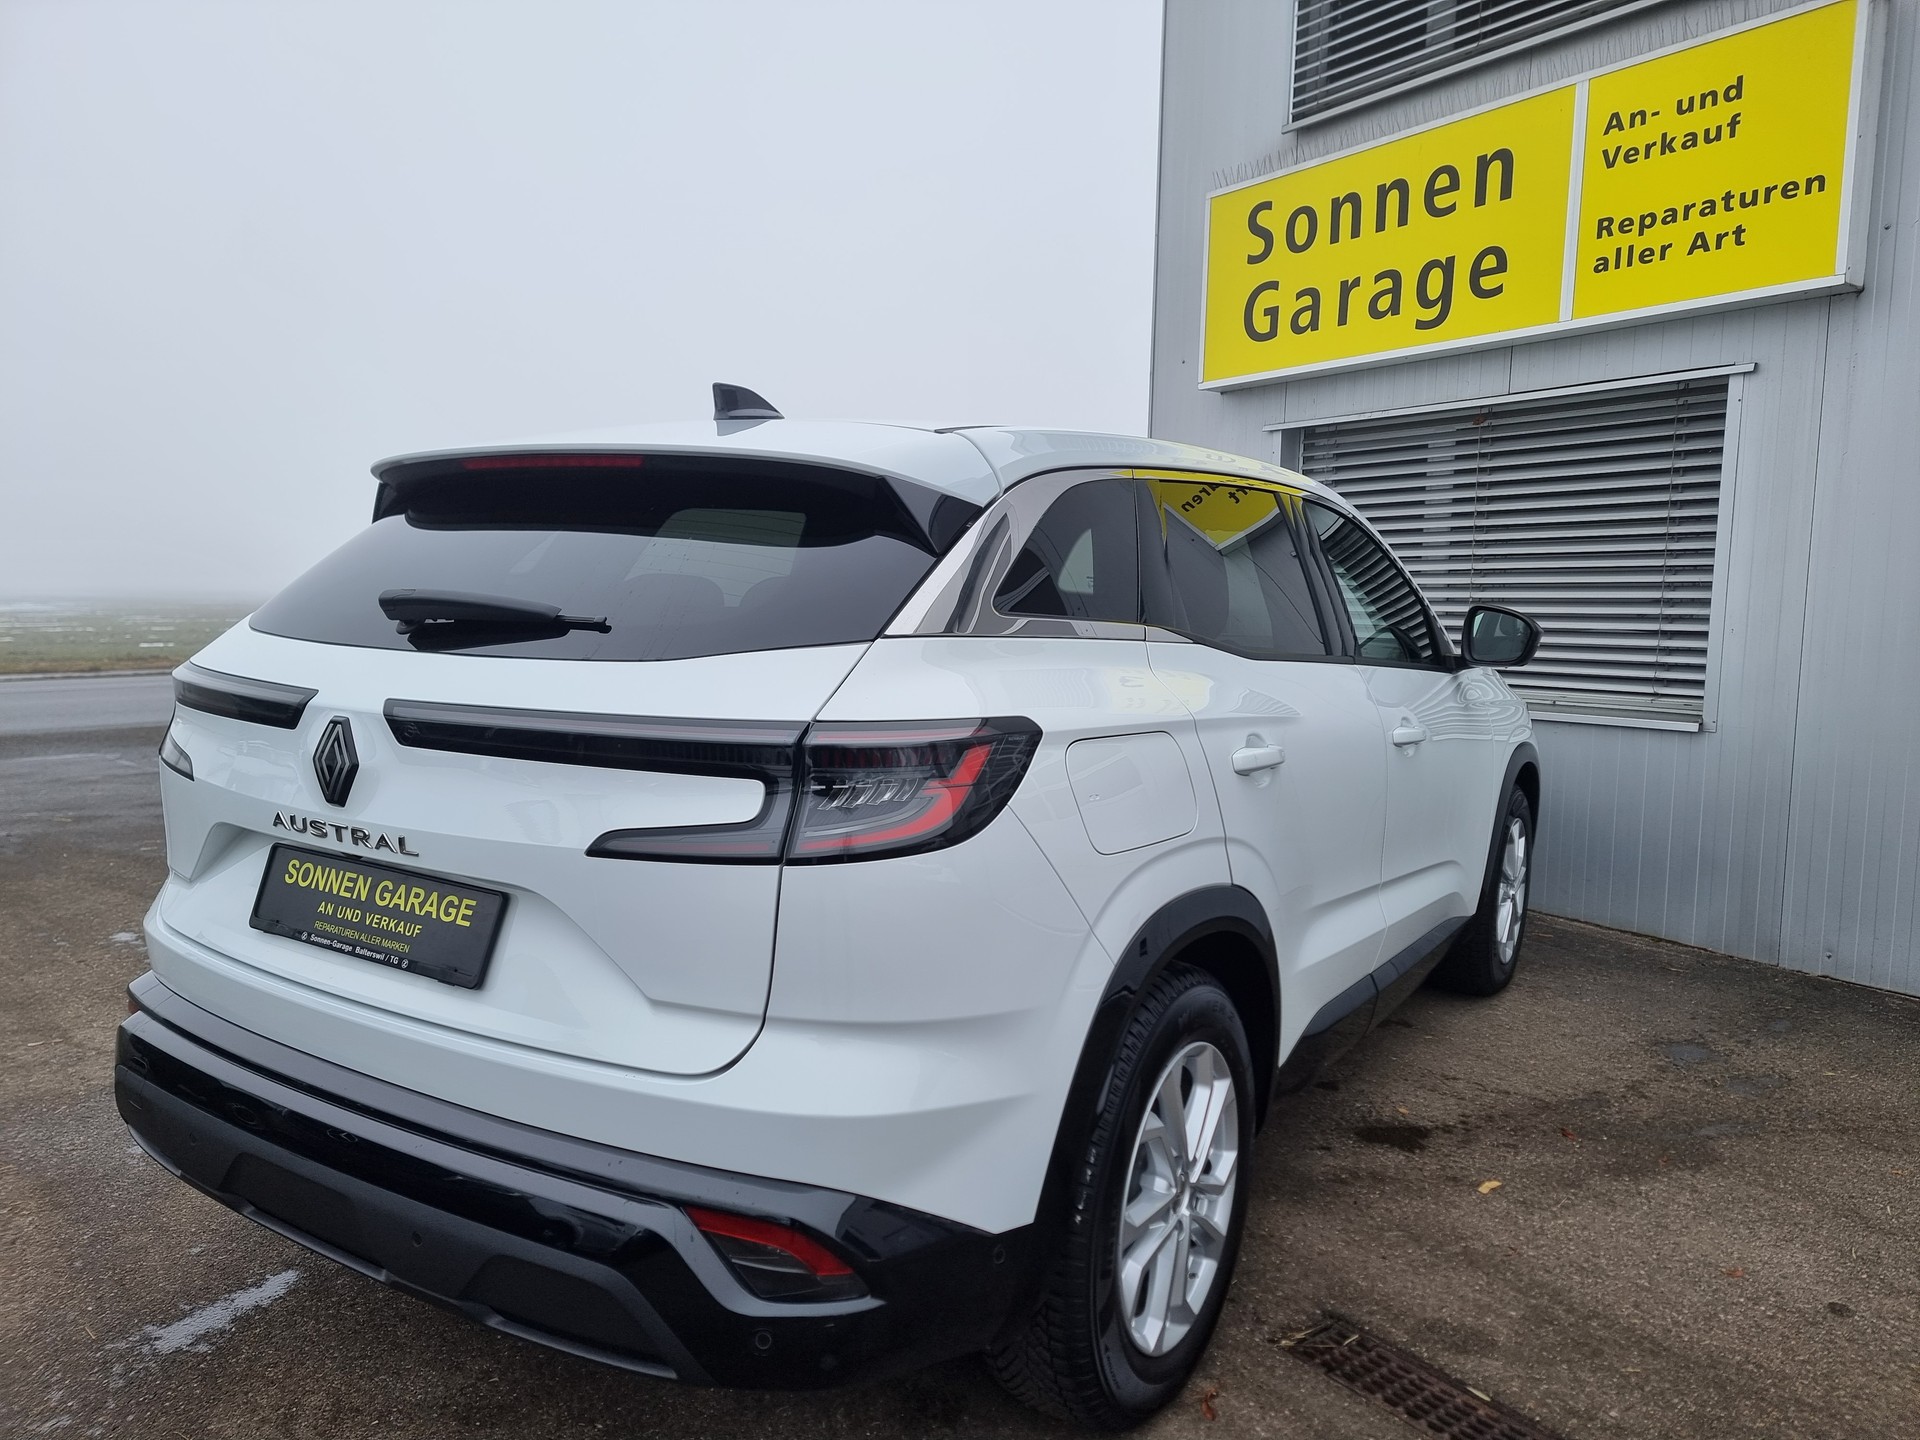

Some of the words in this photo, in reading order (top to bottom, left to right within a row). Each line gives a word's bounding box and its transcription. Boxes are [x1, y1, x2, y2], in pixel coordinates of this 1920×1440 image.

[1603, 109, 1661, 137] An-
[1676, 75, 1745, 118] und
[1602, 113, 1744, 171] Verkauf
[1246, 146, 1516, 266] Sonnen
[1596, 173, 1828, 240] Reparaturen
[1593, 240, 1673, 275] aller
[1687, 222, 1748, 256] Art
[1243, 243, 1509, 344] Garage
[272, 810, 419, 857] AUSTRAL
[284, 859, 372, 902] SONNEN
[375, 880, 477, 927] GARAGE
[317, 901, 335, 916] AN
[337, 907, 362, 922] UND
[366, 912, 423, 938] VERKAUF
[310, 933, 353, 953] Sonnen-Garage
[355, 946, 385, 960] Balterswil
[390, 955, 399, 965] TG
[314, 920, 360, 940] REPARATUREN
[359, 933, 381, 945] ALLER
[381, 938, 410, 953] MARKEN
